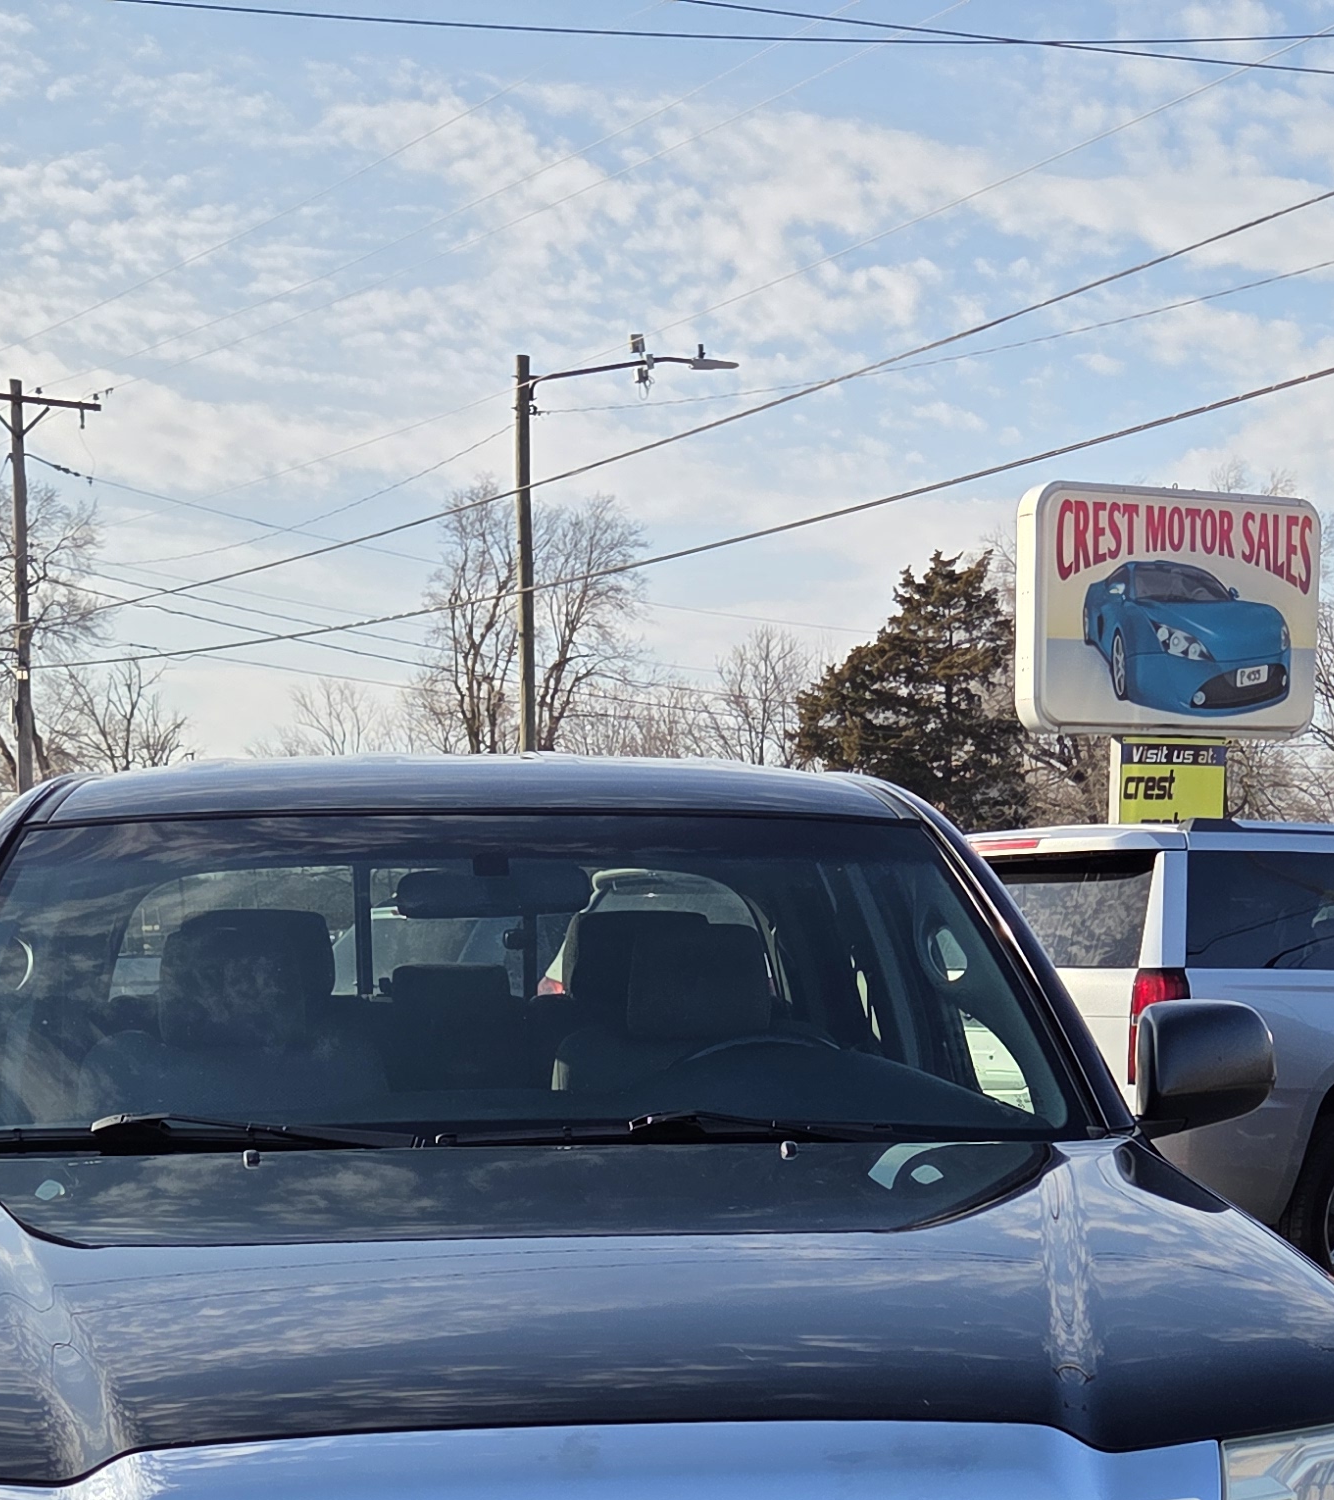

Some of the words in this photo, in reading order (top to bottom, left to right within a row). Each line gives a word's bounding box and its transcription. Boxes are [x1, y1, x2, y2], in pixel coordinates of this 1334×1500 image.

[1056, 499, 1139, 581] CREST
[1145, 505, 1235, 559] MOTOR
[1241, 511, 1312, 595] SALES
[1133, 746, 1168, 763] Visit
[1172, 750, 1195, 763] us
[1198, 748, 1217, 764] at:
[1123, 769, 1175, 800] crest
